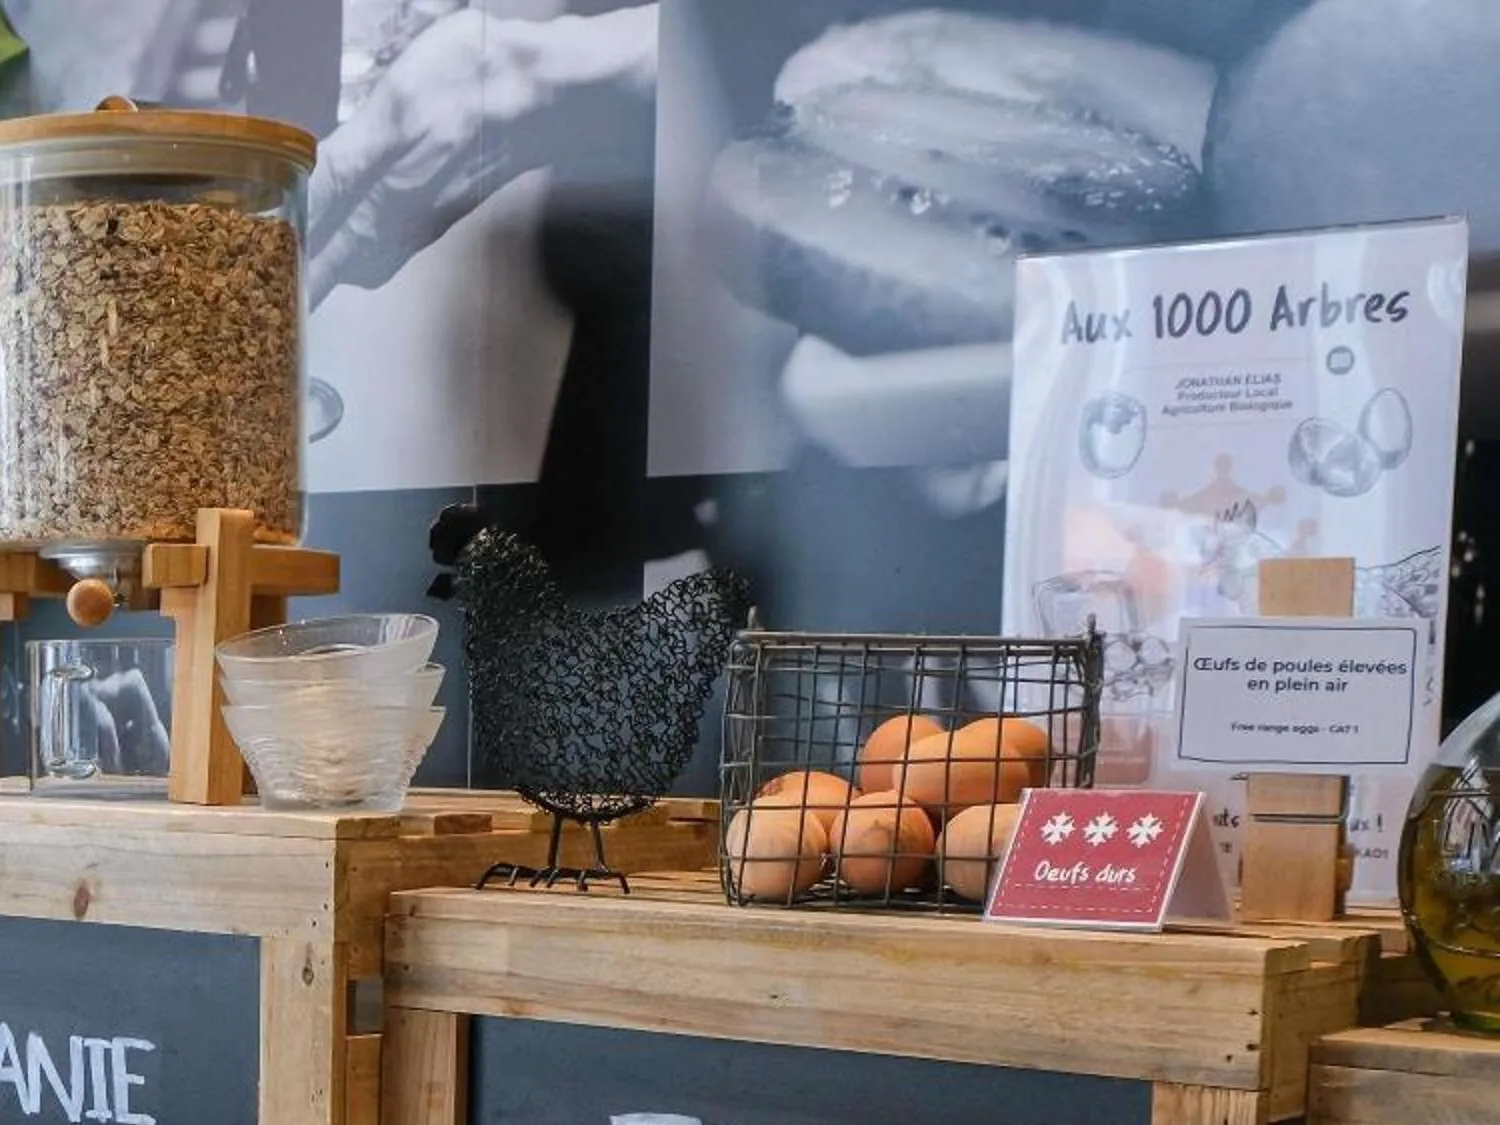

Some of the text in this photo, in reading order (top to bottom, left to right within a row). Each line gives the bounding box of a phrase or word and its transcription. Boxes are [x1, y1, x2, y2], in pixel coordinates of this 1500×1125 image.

[1061, 282, 1412, 344] Aux 1000 Arbres
[1245, 657, 1268, 673] de
[1272, 658, 1333, 679] poules
[1338, 657, 1408, 675] élevées
[1247, 677, 1350, 694] en plein air
[1034, 859, 1137, 884] Oeufs durs
